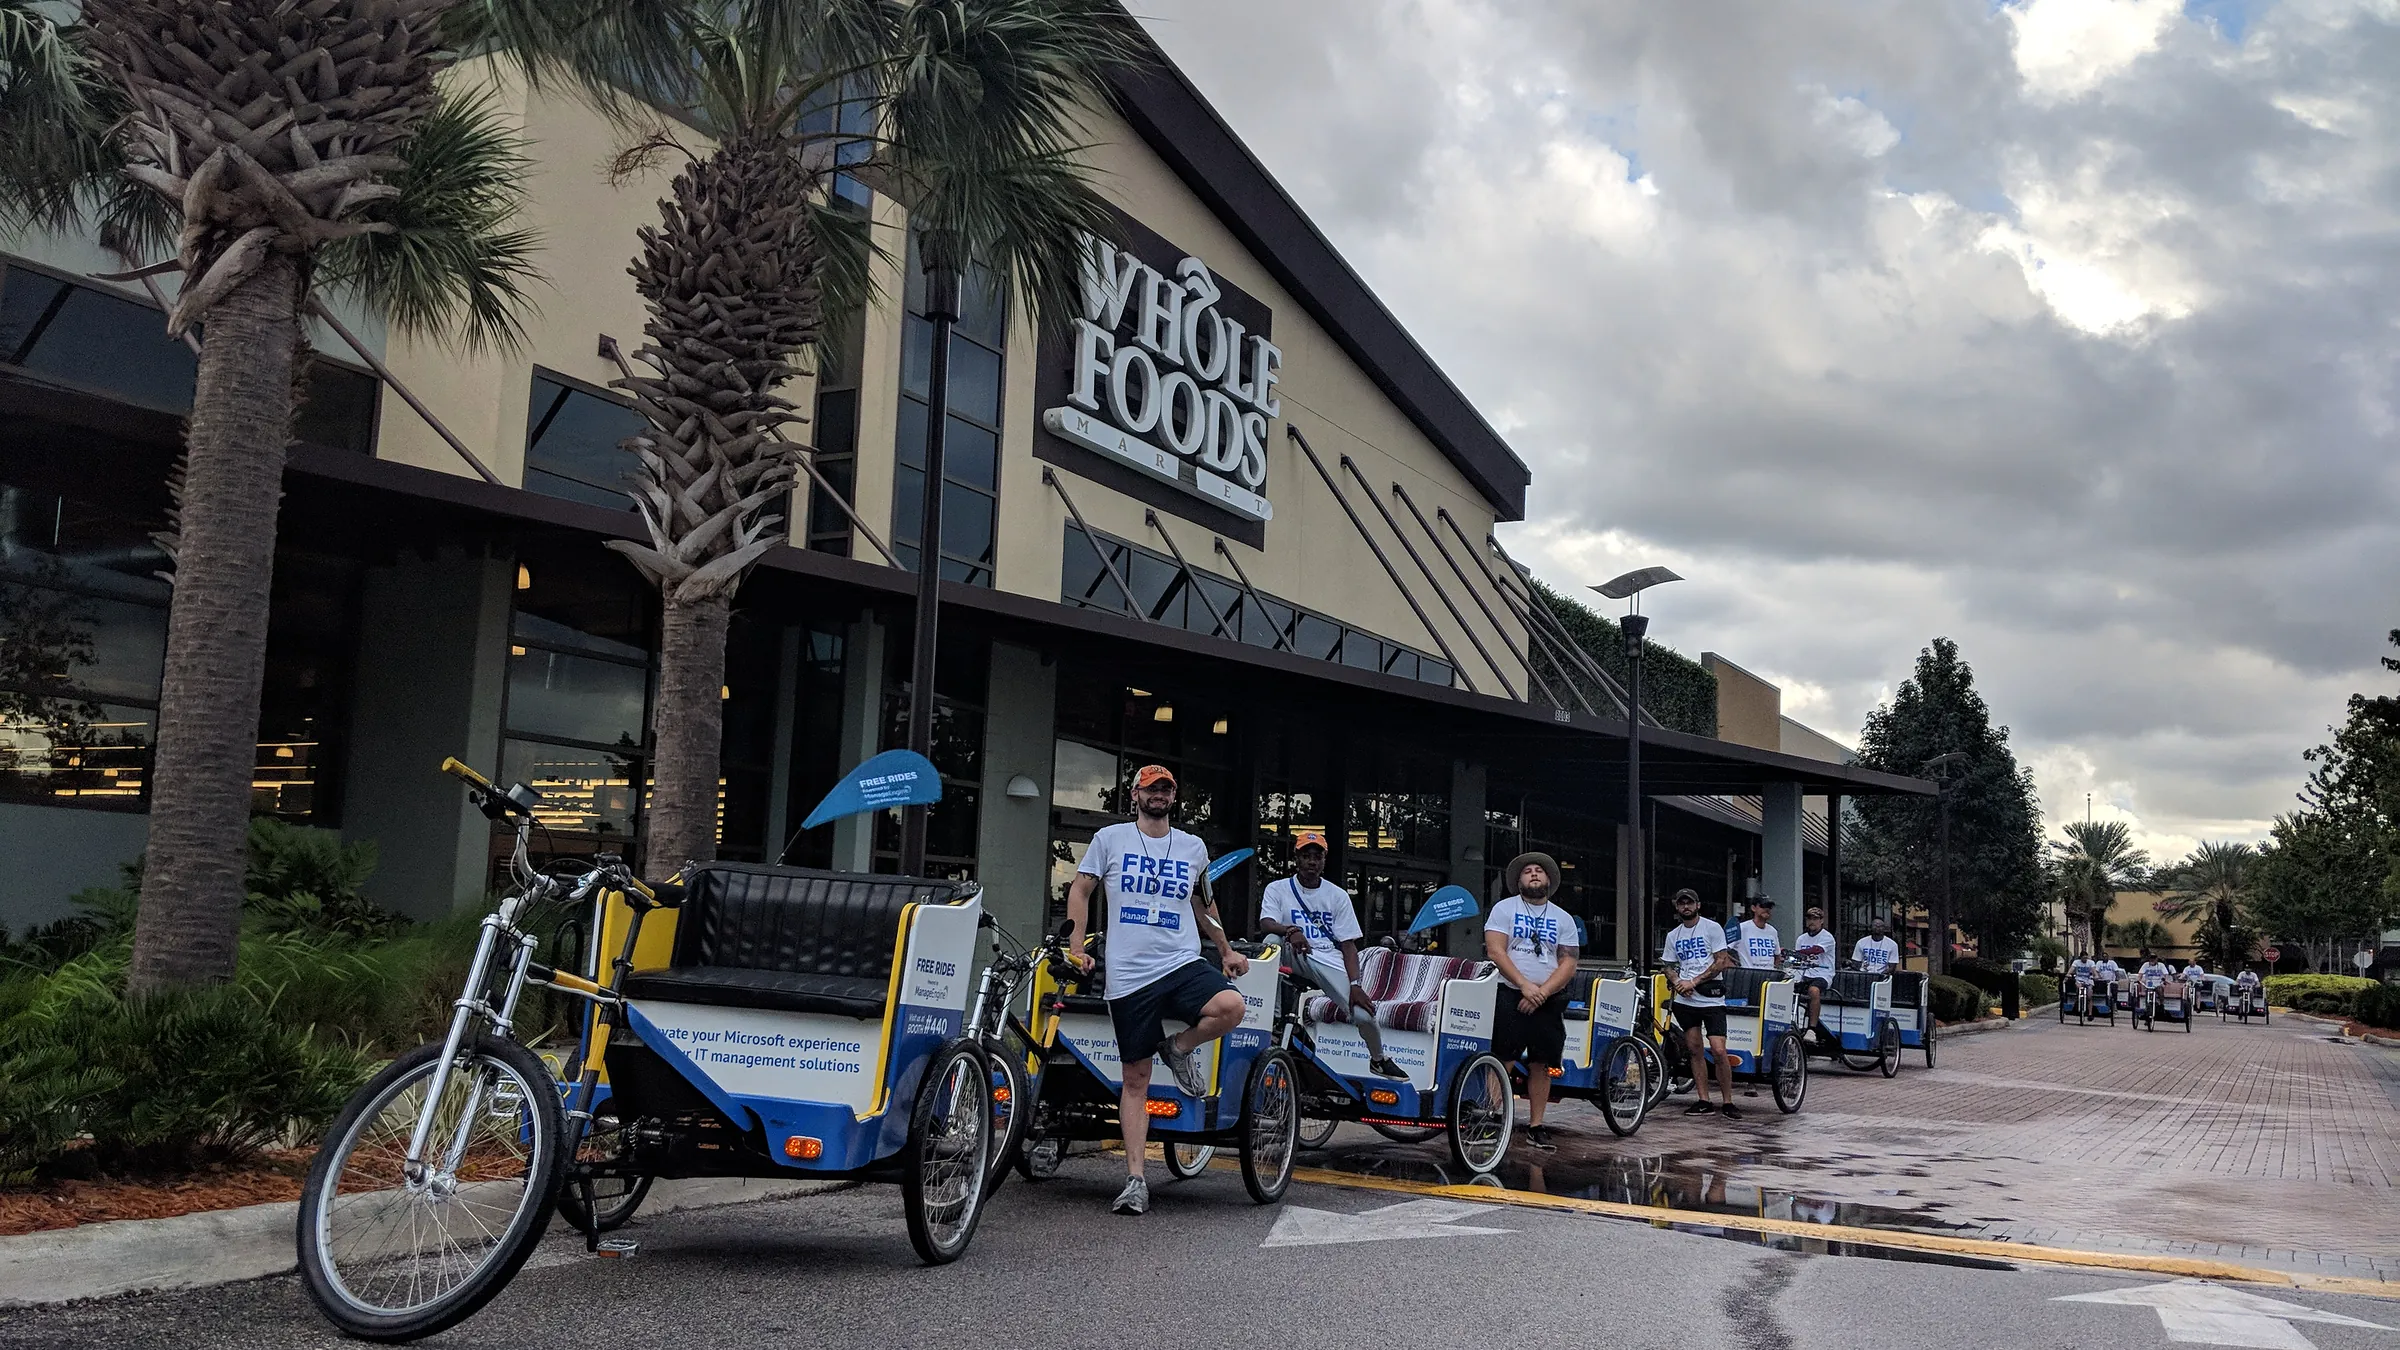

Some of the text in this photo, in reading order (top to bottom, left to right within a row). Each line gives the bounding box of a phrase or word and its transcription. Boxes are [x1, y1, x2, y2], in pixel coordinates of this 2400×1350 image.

[1075, 230, 1282, 419] WHOLE
[1067, 317, 1267, 488] FOODS
[859, 771, 918, 788] FREE RIDES
[1122, 853, 1189, 881] FREE
[1121, 874, 1189, 900] RIDES
[1433, 902, 1448, 910] FREE
[1514, 912, 1557, 931] FREE
[1513, 926, 1558, 944] RIDES
[1748, 938, 1776, 948] FREE
[1675, 936, 1705, 953] FREE
[1862, 948, 1888, 957] FREE
[1677, 948, 1708, 961] RIDES
[916, 958, 956, 977] FREE RIDES
[914, 985, 949, 1002] ManageEngine
[1248, 996, 1264, 1008] RIDES
[1450, 1007, 1481, 1020] FREE RIDES
[906, 1014, 948, 1035] BOOTH #440
[691, 1030, 722, 1043] your
[724, 1030, 785, 1048] Microsoft
[788, 1038, 861, 1053] experience
[1091, 1039, 1111, 1049] your
[1242, 1033, 1260, 1048] #440
[1318, 1035, 1341, 1046] Elevate
[1342, 1040, 1356, 1049] your
[1389, 1044, 1425, 1056] experience
[1459, 1039, 1478, 1052] #440
[695, 1048, 708, 1061] IT
[711, 1052, 796, 1069] management
[799, 1058, 860, 1073] solutions
[1093, 1051, 1103, 1061] IT
[1316, 1046, 1331, 1055] with
[1343, 1049, 1351, 1057] IT
[1394, 1056, 1425, 1067] solutions
